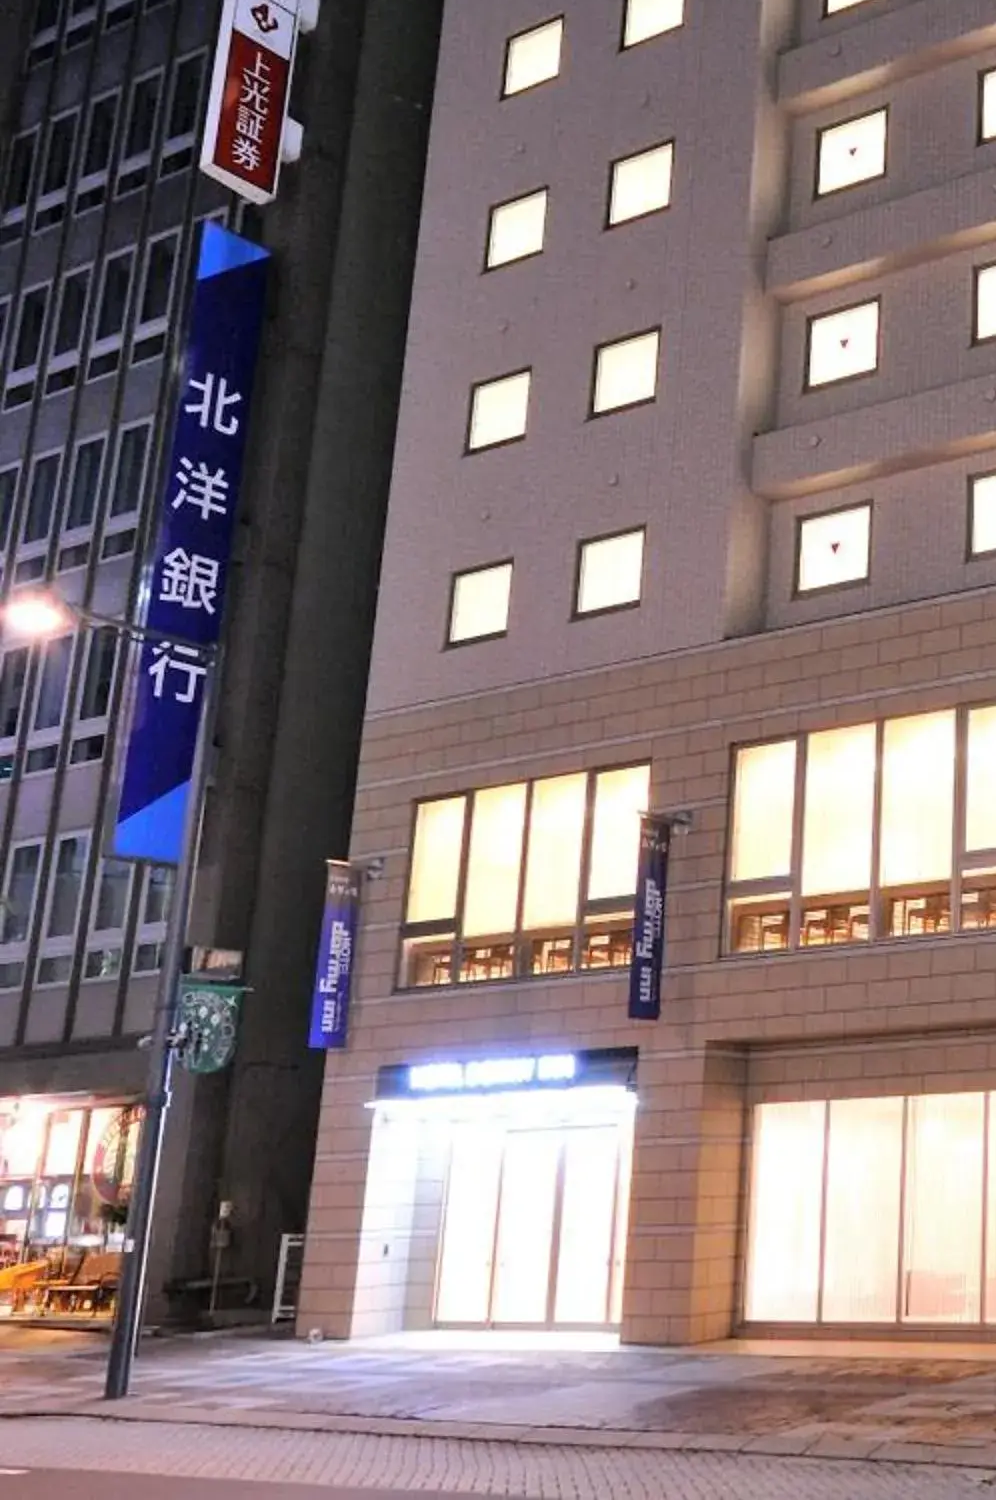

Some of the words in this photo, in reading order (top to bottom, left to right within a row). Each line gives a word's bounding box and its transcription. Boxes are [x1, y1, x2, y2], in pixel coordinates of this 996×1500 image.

[231, 50, 272, 172] 上光証券
[148, 372, 243, 704] 北洋銀行
[319, 920, 350, 994] dormy
[639, 966, 653, 1003] inn
[321, 1000, 337, 1034] inn
